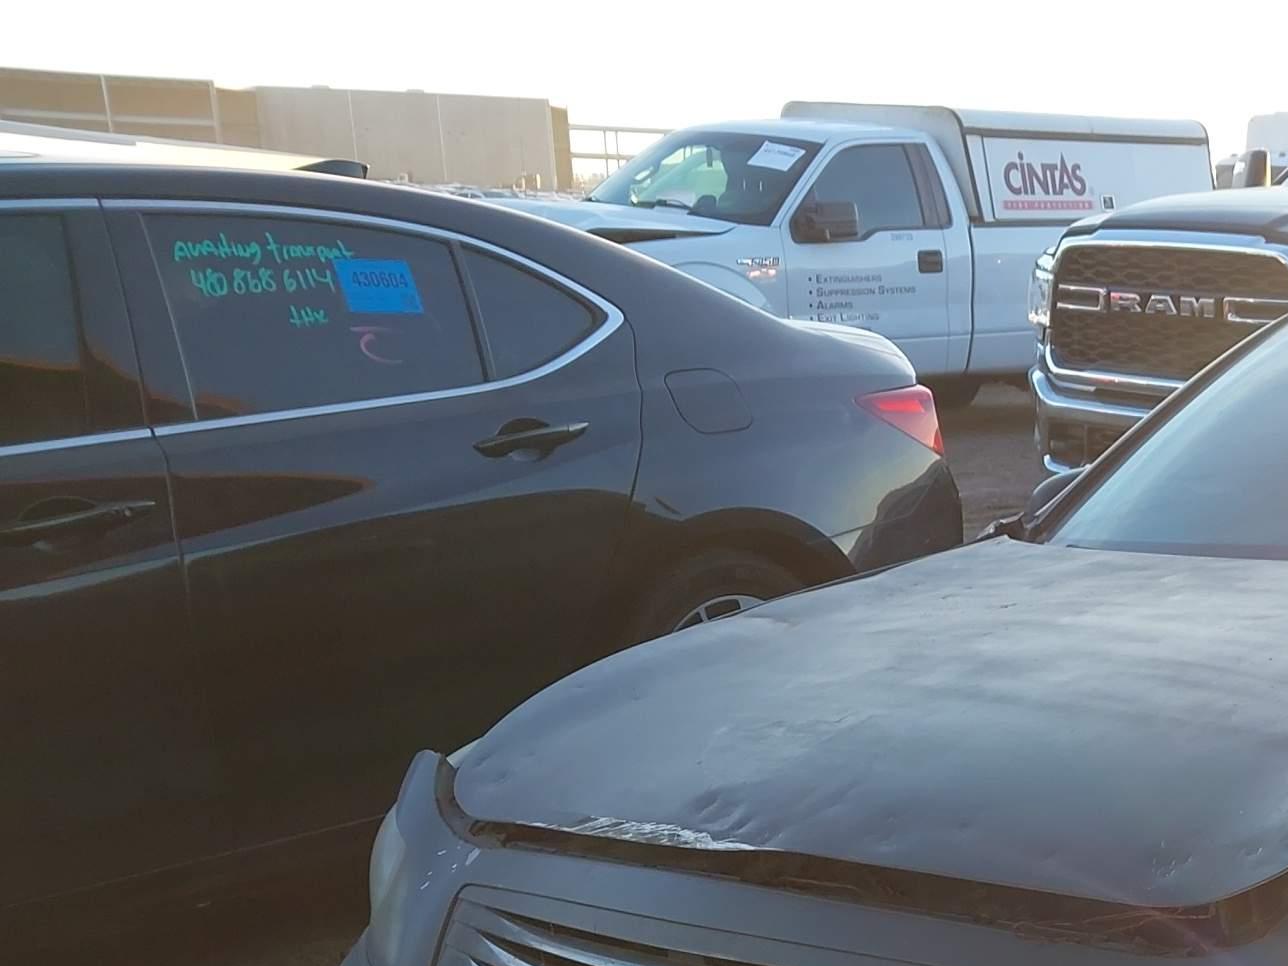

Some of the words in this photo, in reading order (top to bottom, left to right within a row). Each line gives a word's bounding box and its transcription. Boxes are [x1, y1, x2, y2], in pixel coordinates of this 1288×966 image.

[233, 267, 276, 294] 868
[283, 268, 336, 293] 6114
[1110, 291, 1216, 318] RAM
